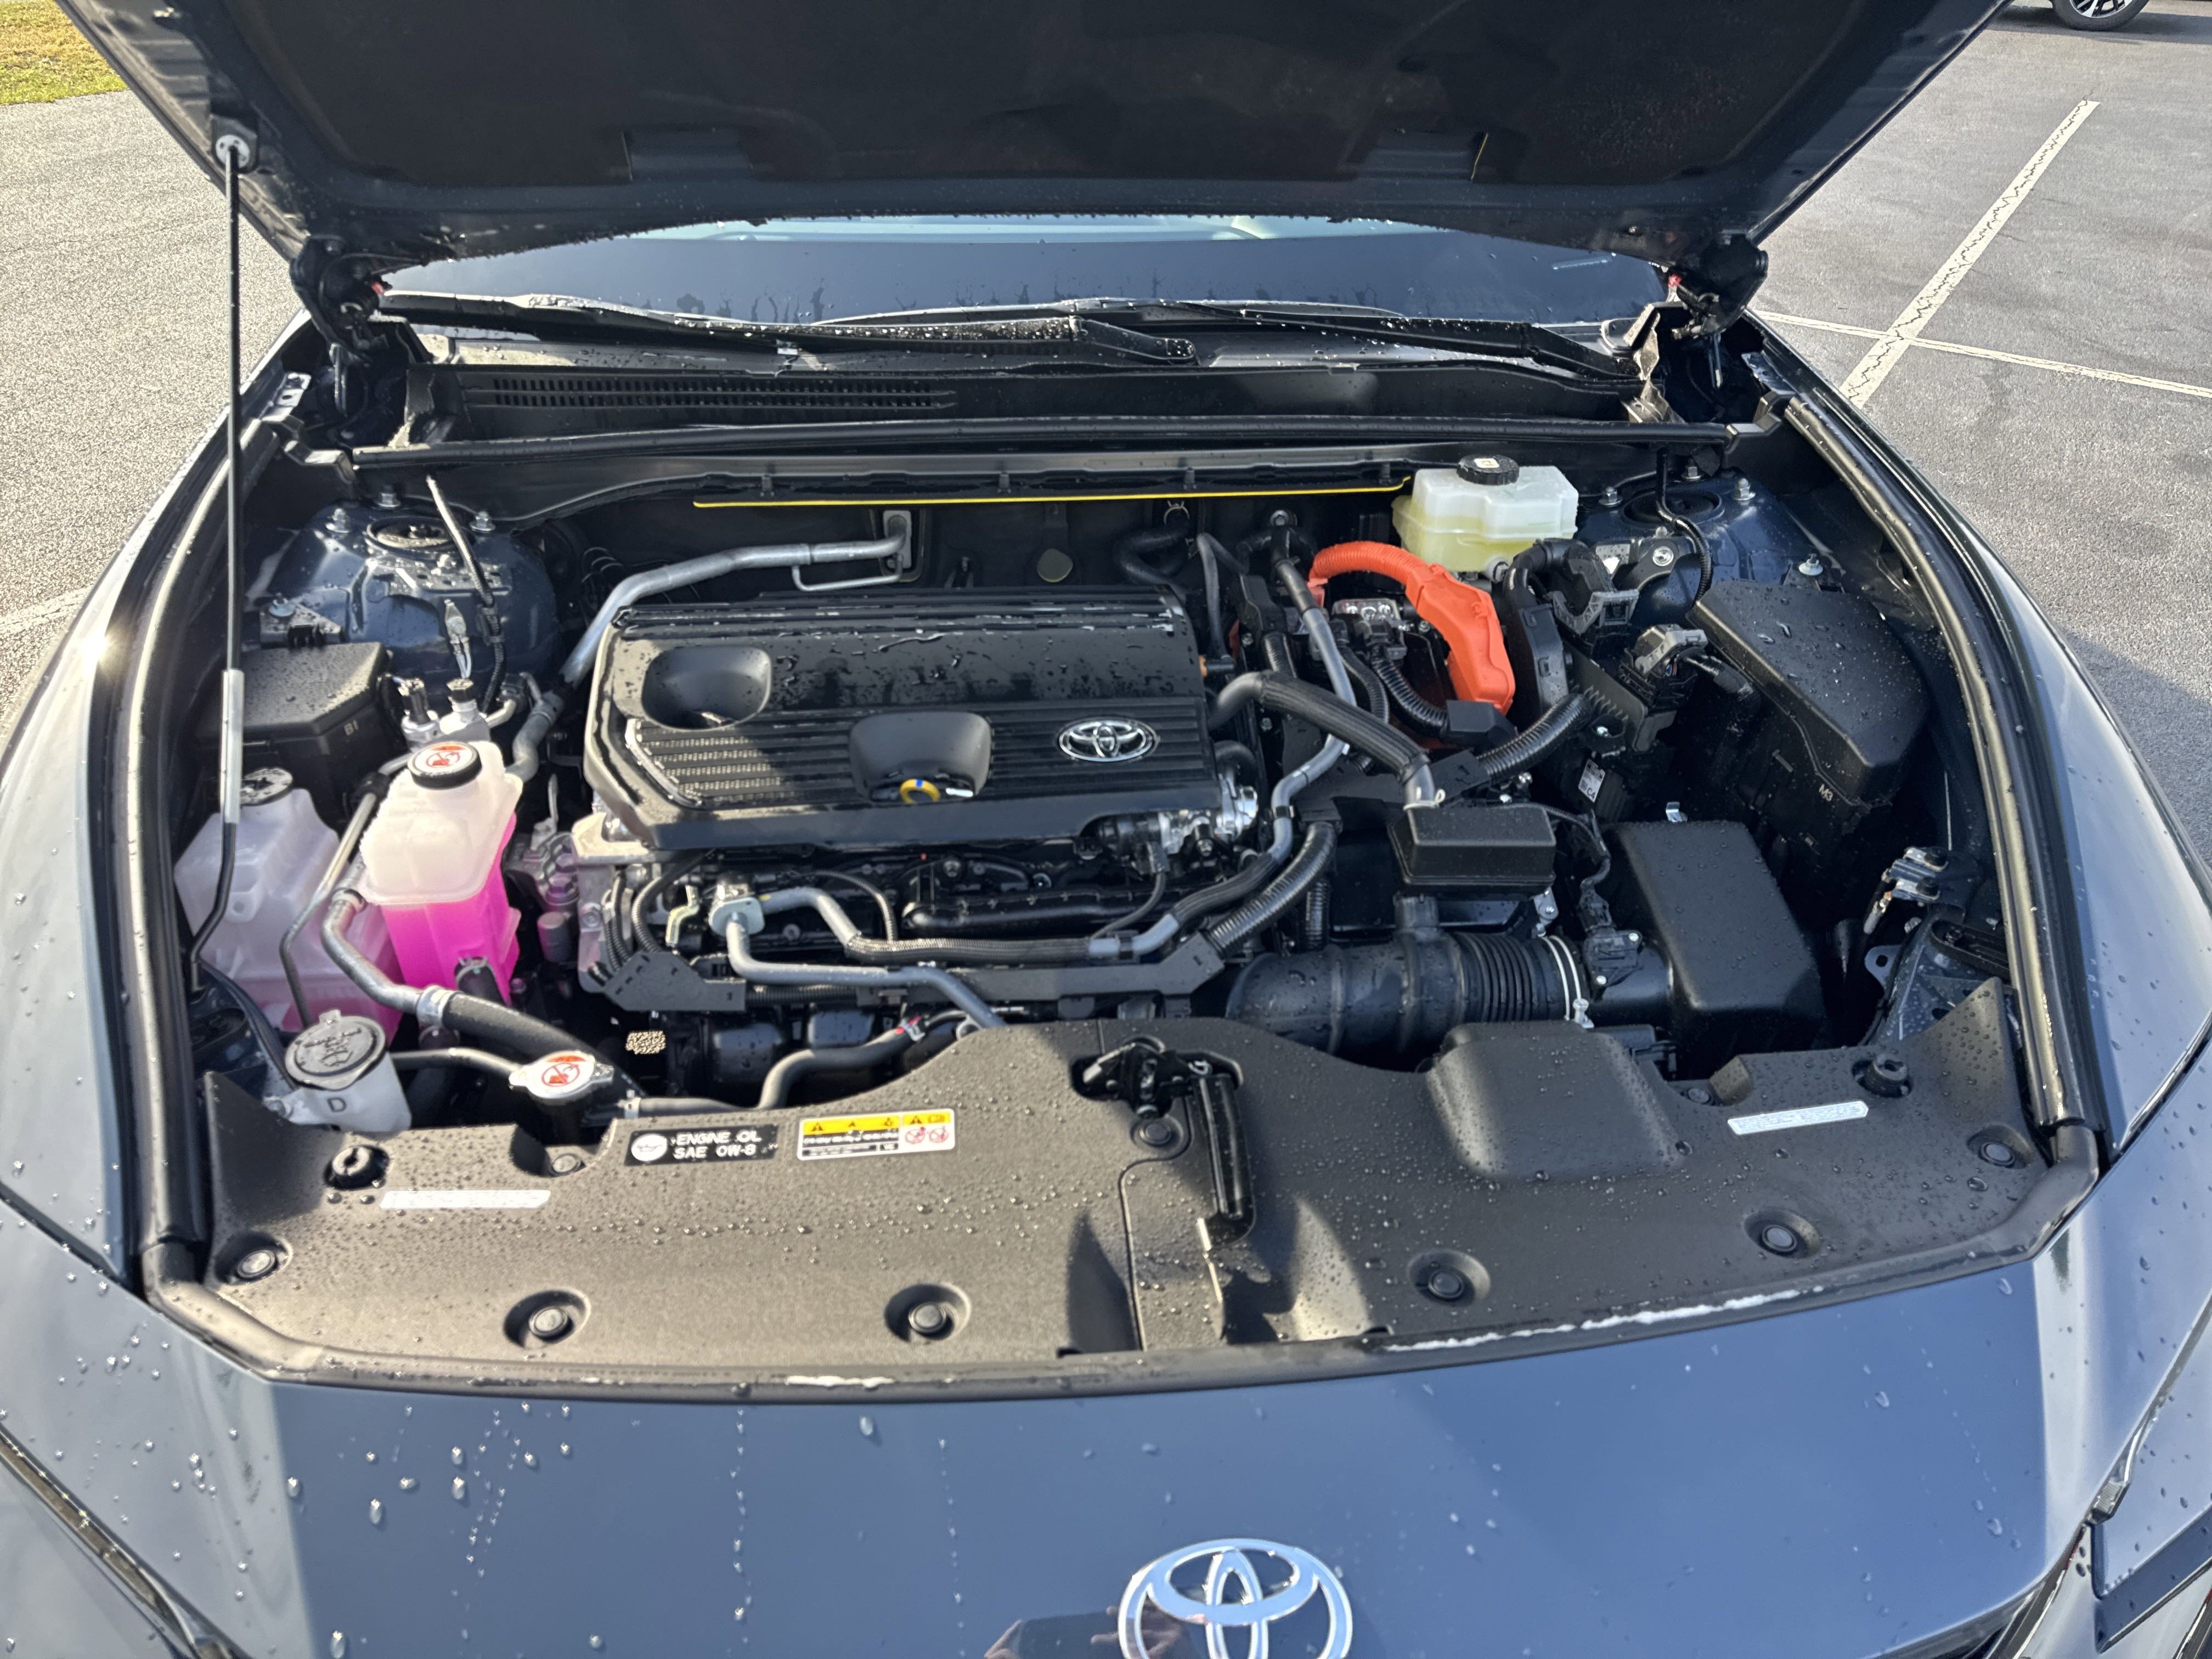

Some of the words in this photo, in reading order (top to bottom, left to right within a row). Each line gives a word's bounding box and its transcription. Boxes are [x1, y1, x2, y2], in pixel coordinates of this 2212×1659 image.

[326, 1097, 347, 1112] D
[676, 1131, 731, 1145] ENGINE
[673, 1147, 708, 1159] SAE
